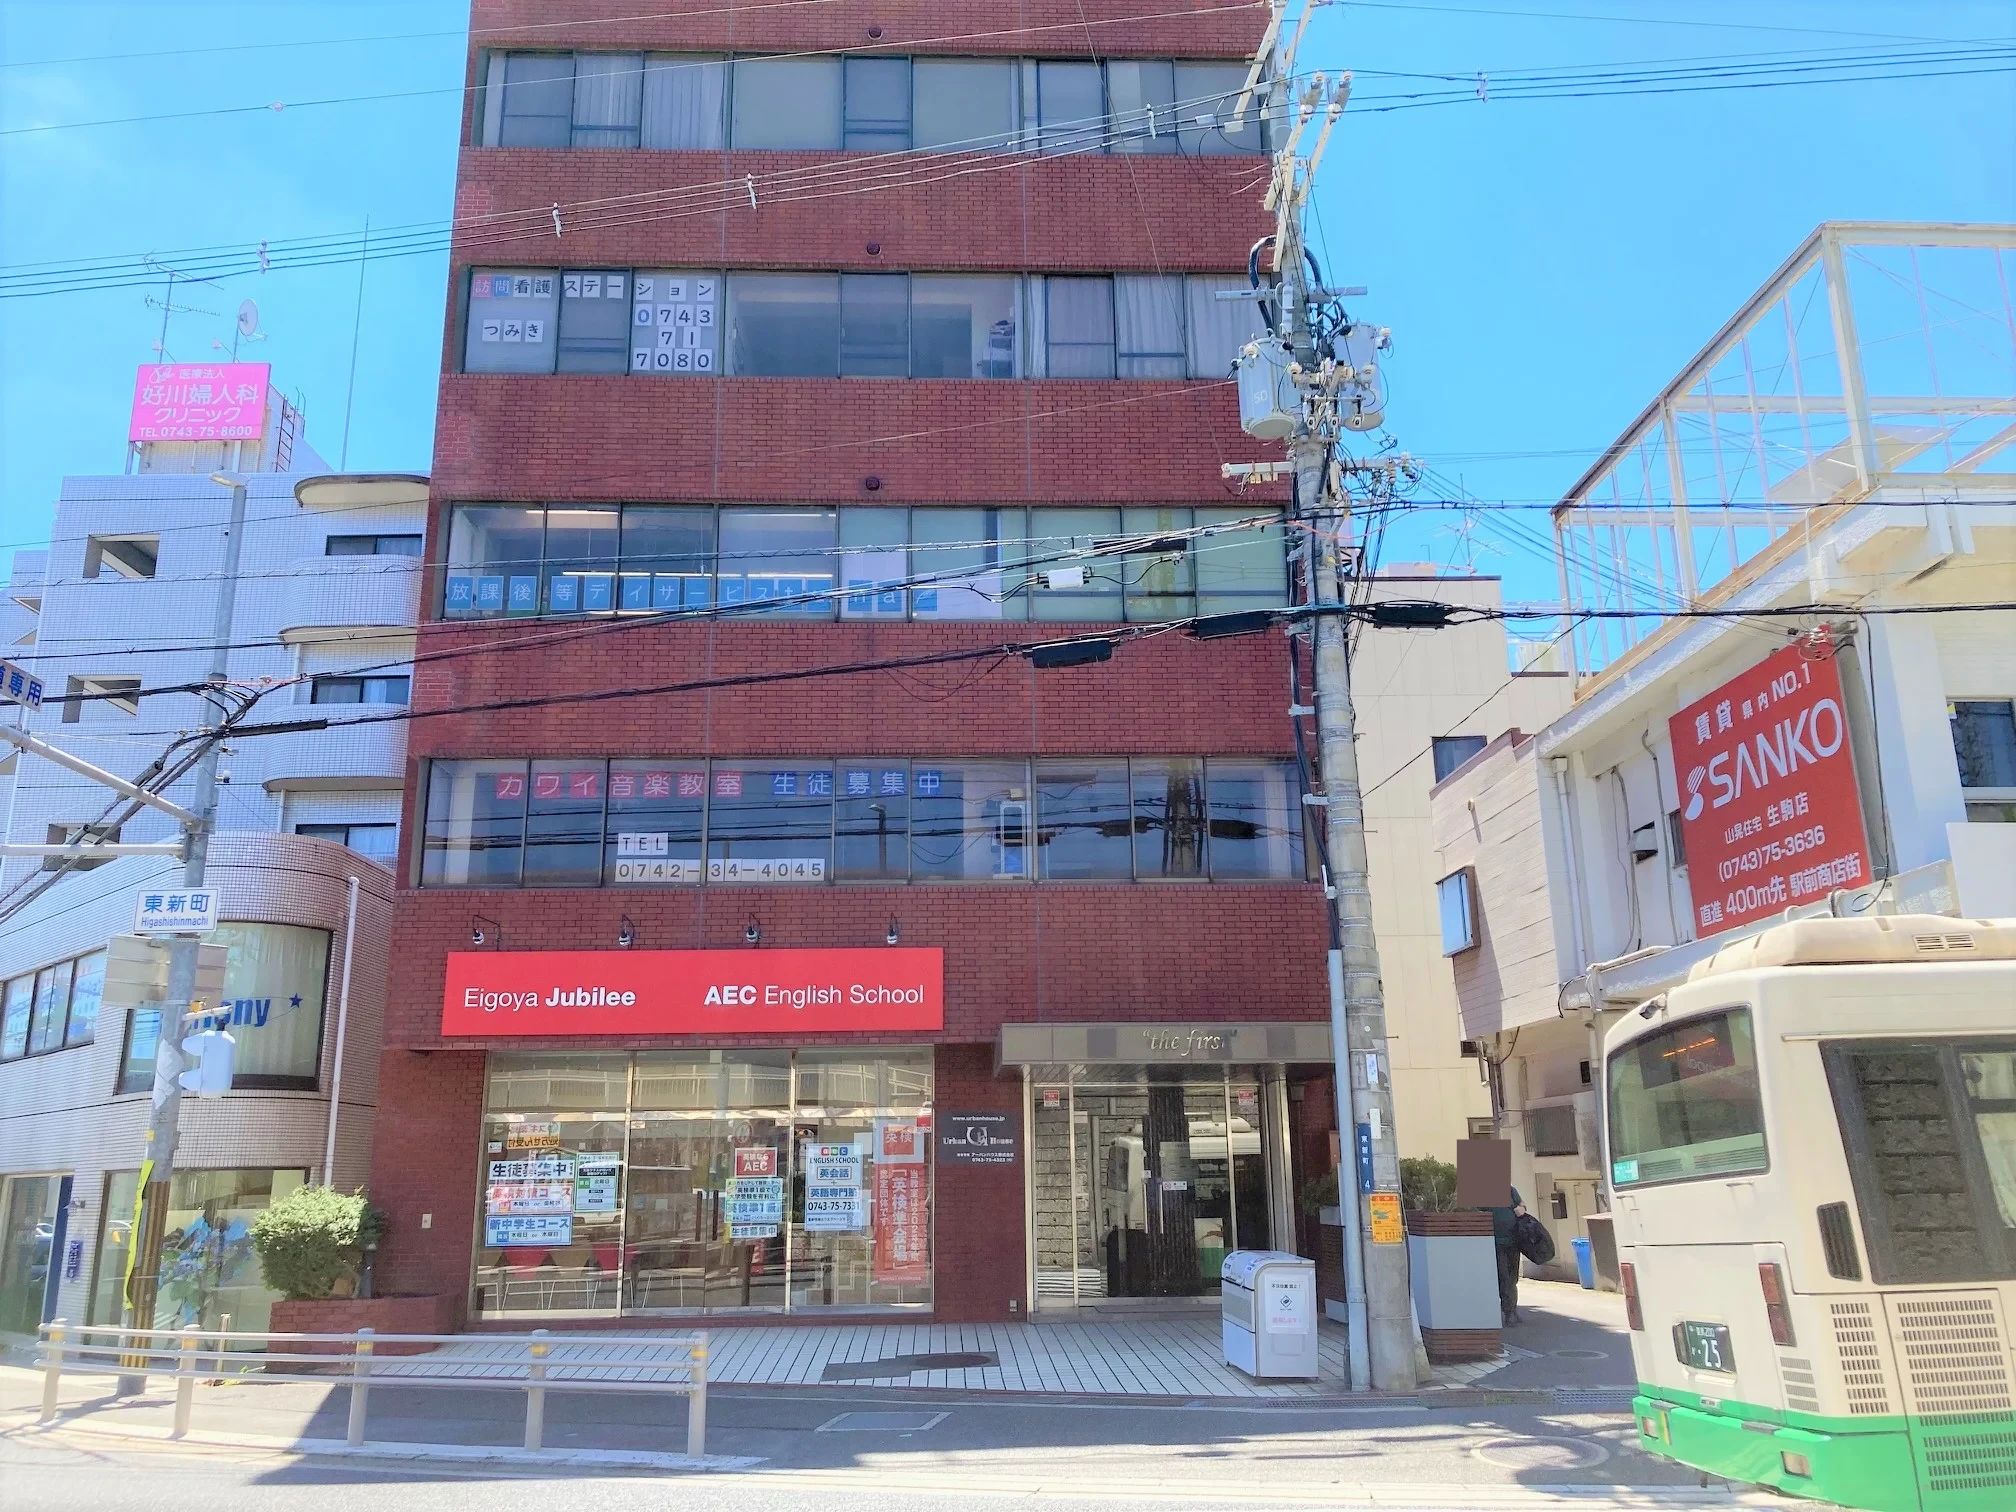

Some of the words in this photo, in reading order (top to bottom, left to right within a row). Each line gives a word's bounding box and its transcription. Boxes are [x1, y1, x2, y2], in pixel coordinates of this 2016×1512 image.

[637, 308, 712, 325] 0743
[483, 321, 540, 339] つみき
[660, 331, 695, 346] 71
[636, 353, 710, 368] 7080
[179, 367, 225, 380] 医療法人
[141, 383, 260, 406] 好川婦人科
[154, 406, 241, 424] クリニック
[139, 427, 158, 438] TEL
[1695, 699, 1734, 746] 賃貸
[1741, 690, 1769, 720] 県内
[1772, 661, 1811, 702] NO.1
[1708, 698, 1844, 809] SANKO
[499, 770, 742, 798] カワイ音楽教室
[773, 769, 942, 796] 生徒募集中
[1766, 791, 1810, 829] 生駒店
[621, 836, 665, 852] TEL
[1718, 824, 1826, 883] (0743)75-3636
[617, 862, 823, 879] 0742-34-4045
[1699, 900, 1723, 928] 直進
[1725, 874, 1787, 916] 400m先
[1789, 851, 1863, 898] 駅前商店街
[142, 894, 211, 914] 東新町
[141, 916, 209, 928] Higashishinmachi
[463, 987, 540, 1012] Eigoya
[545, 987, 637, 1007] Jubilee
[702, 985, 758, 1006] AEC
[764, 984, 842, 1010] English
[849, 984, 925, 1005] School
[743, 1161, 768, 1172] AEC
[835, 1156, 860, 1164] SCHOOL
[818, 1168, 850, 1178] 英会話
[489, 1218, 570, 1230] 新中学生コース
